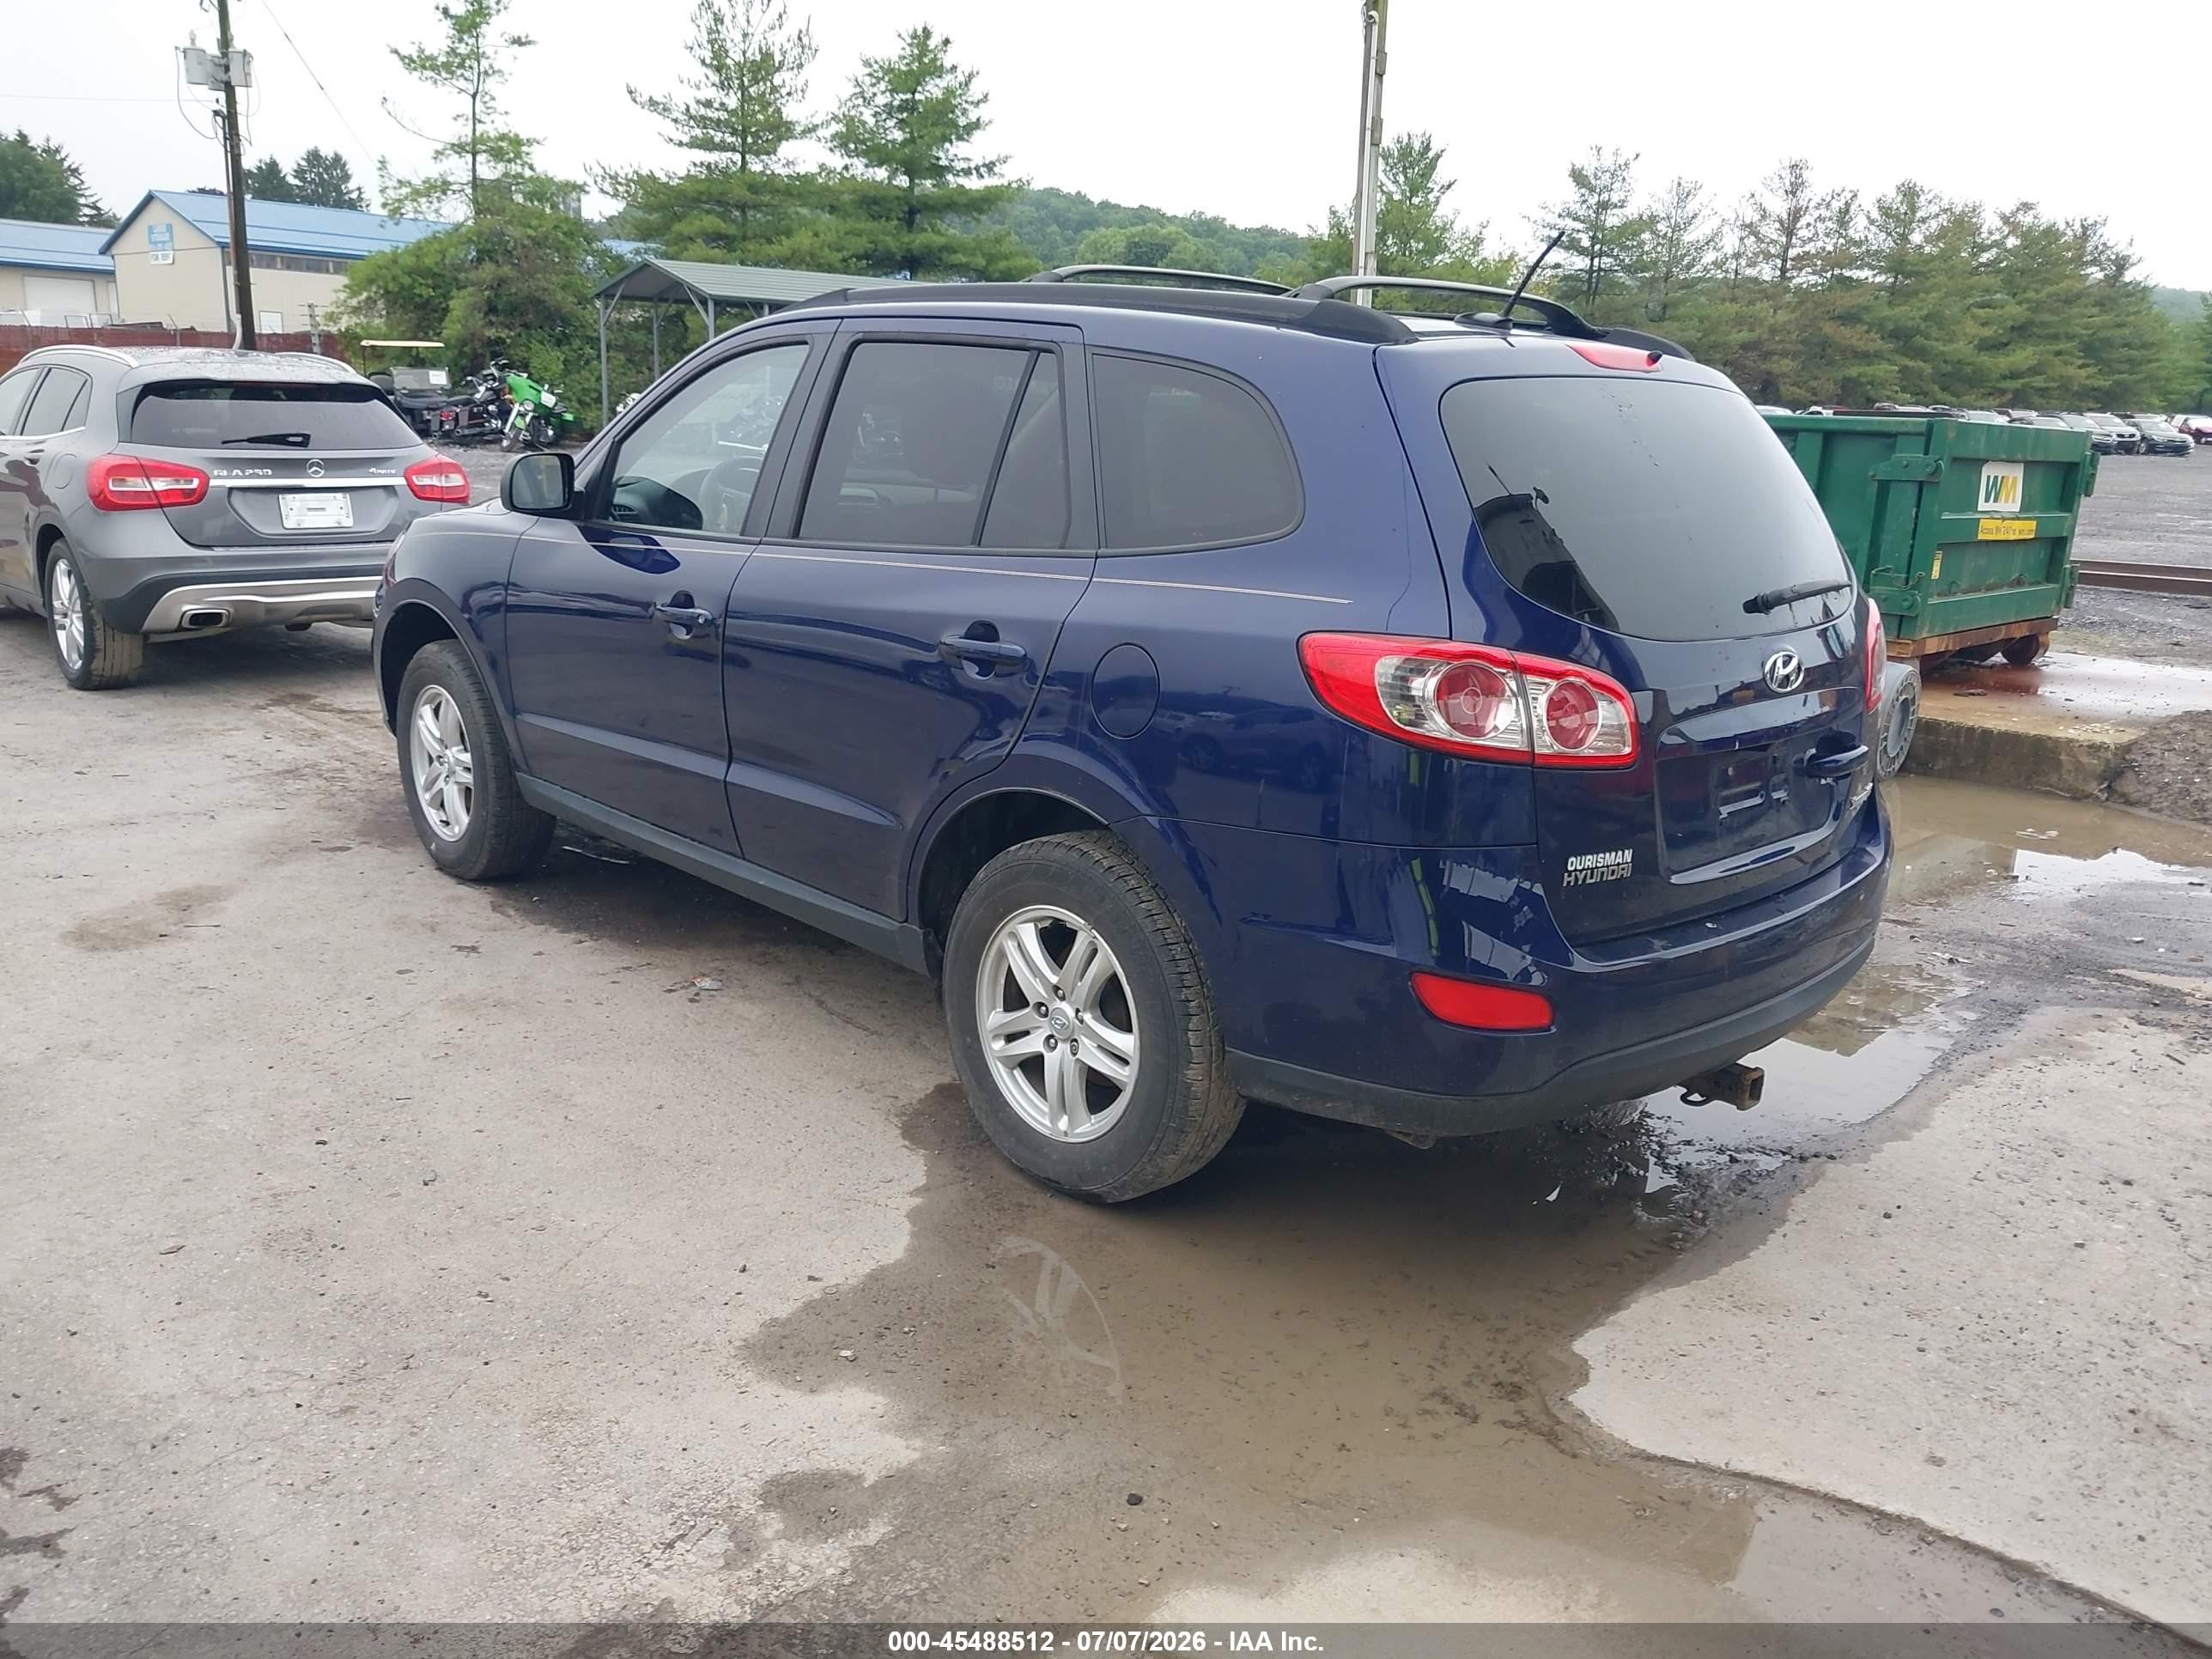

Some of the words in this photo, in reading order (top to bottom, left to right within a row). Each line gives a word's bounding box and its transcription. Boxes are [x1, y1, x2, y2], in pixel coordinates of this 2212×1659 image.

[1984, 475, 2019, 504] WM
[1567, 848, 1633, 871] OURISMAN
[1562, 863, 1633, 887] HYUNDAI
